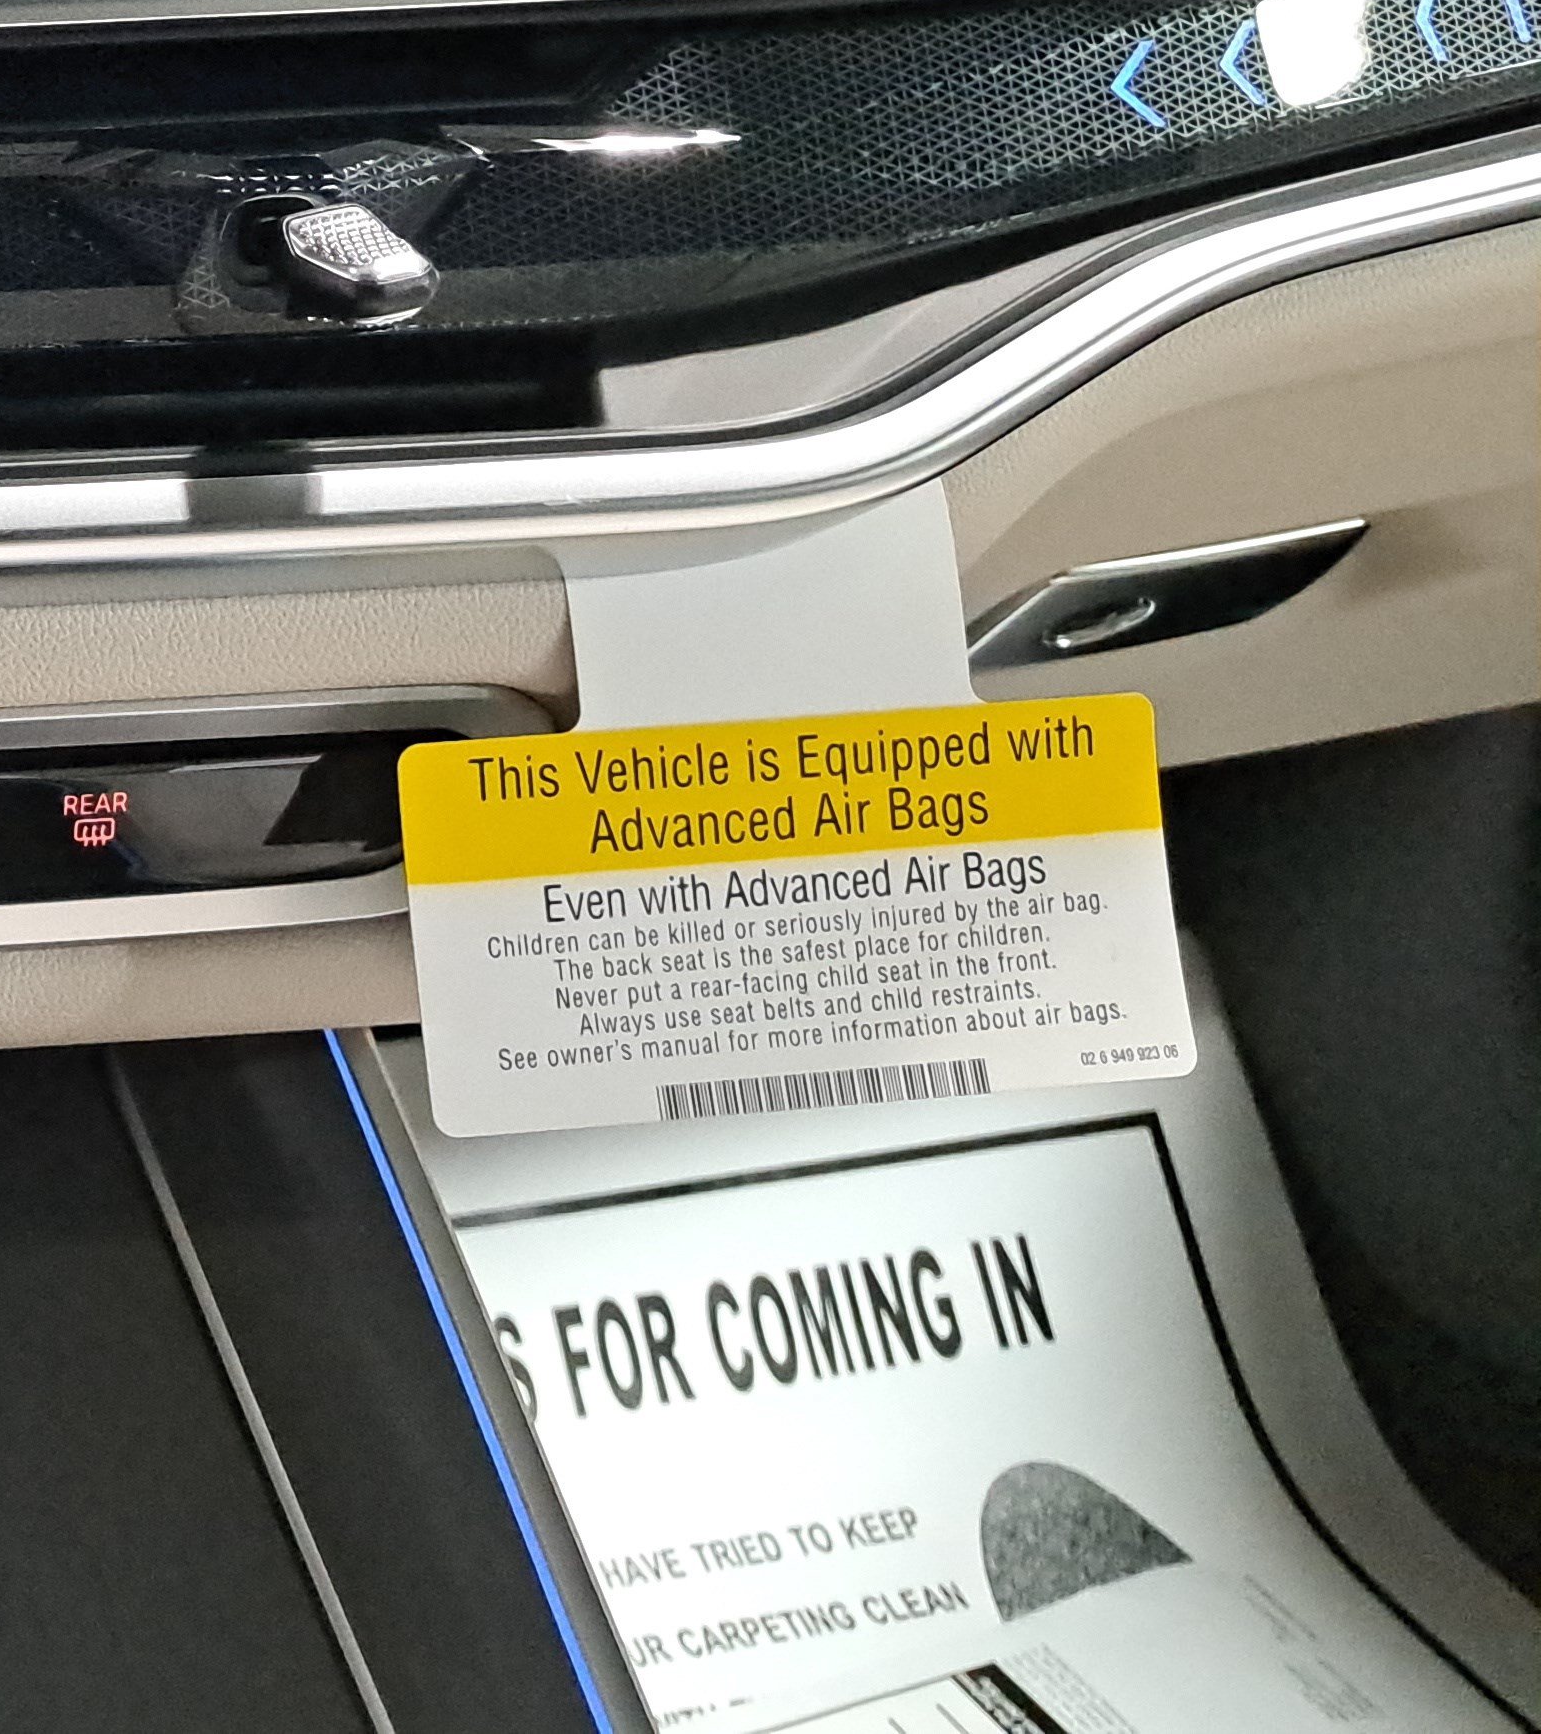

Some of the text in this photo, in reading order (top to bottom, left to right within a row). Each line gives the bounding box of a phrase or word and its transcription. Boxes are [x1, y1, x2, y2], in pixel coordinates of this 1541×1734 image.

[468, 715, 1094, 802] This Vehicle is Equipped with
[63, 791, 128, 816] REAR
[590, 787, 989, 854] Advanced Air Bags
[543, 851, 1046, 923] Even with Advanced Air Bags
[487, 891, 1108, 958] Children can be killed or seriously injured by the air bag.
[554, 923, 1051, 982] The back seat is the safest place for children.
[555, 948, 1057, 1009] Never put a rear-facing child seat in the front.
[579, 979, 1042, 1037] Always use seat belts and child restraints.
[498, 1000, 1128, 1071] See owner's manual for more information about air bags.
[1080, 1051, 1097, 1065] 02
[553, 1291, 697, 1418] FOR
[707, 1248, 963, 1391] COMING
[969, 1233, 1057, 1348] IN
[598, 1506, 919, 1589] HAVE TRIED TO KEEP
[677, 1601, 856, 1659] CARPETING
[860, 1581, 971, 1624] CLEAN
